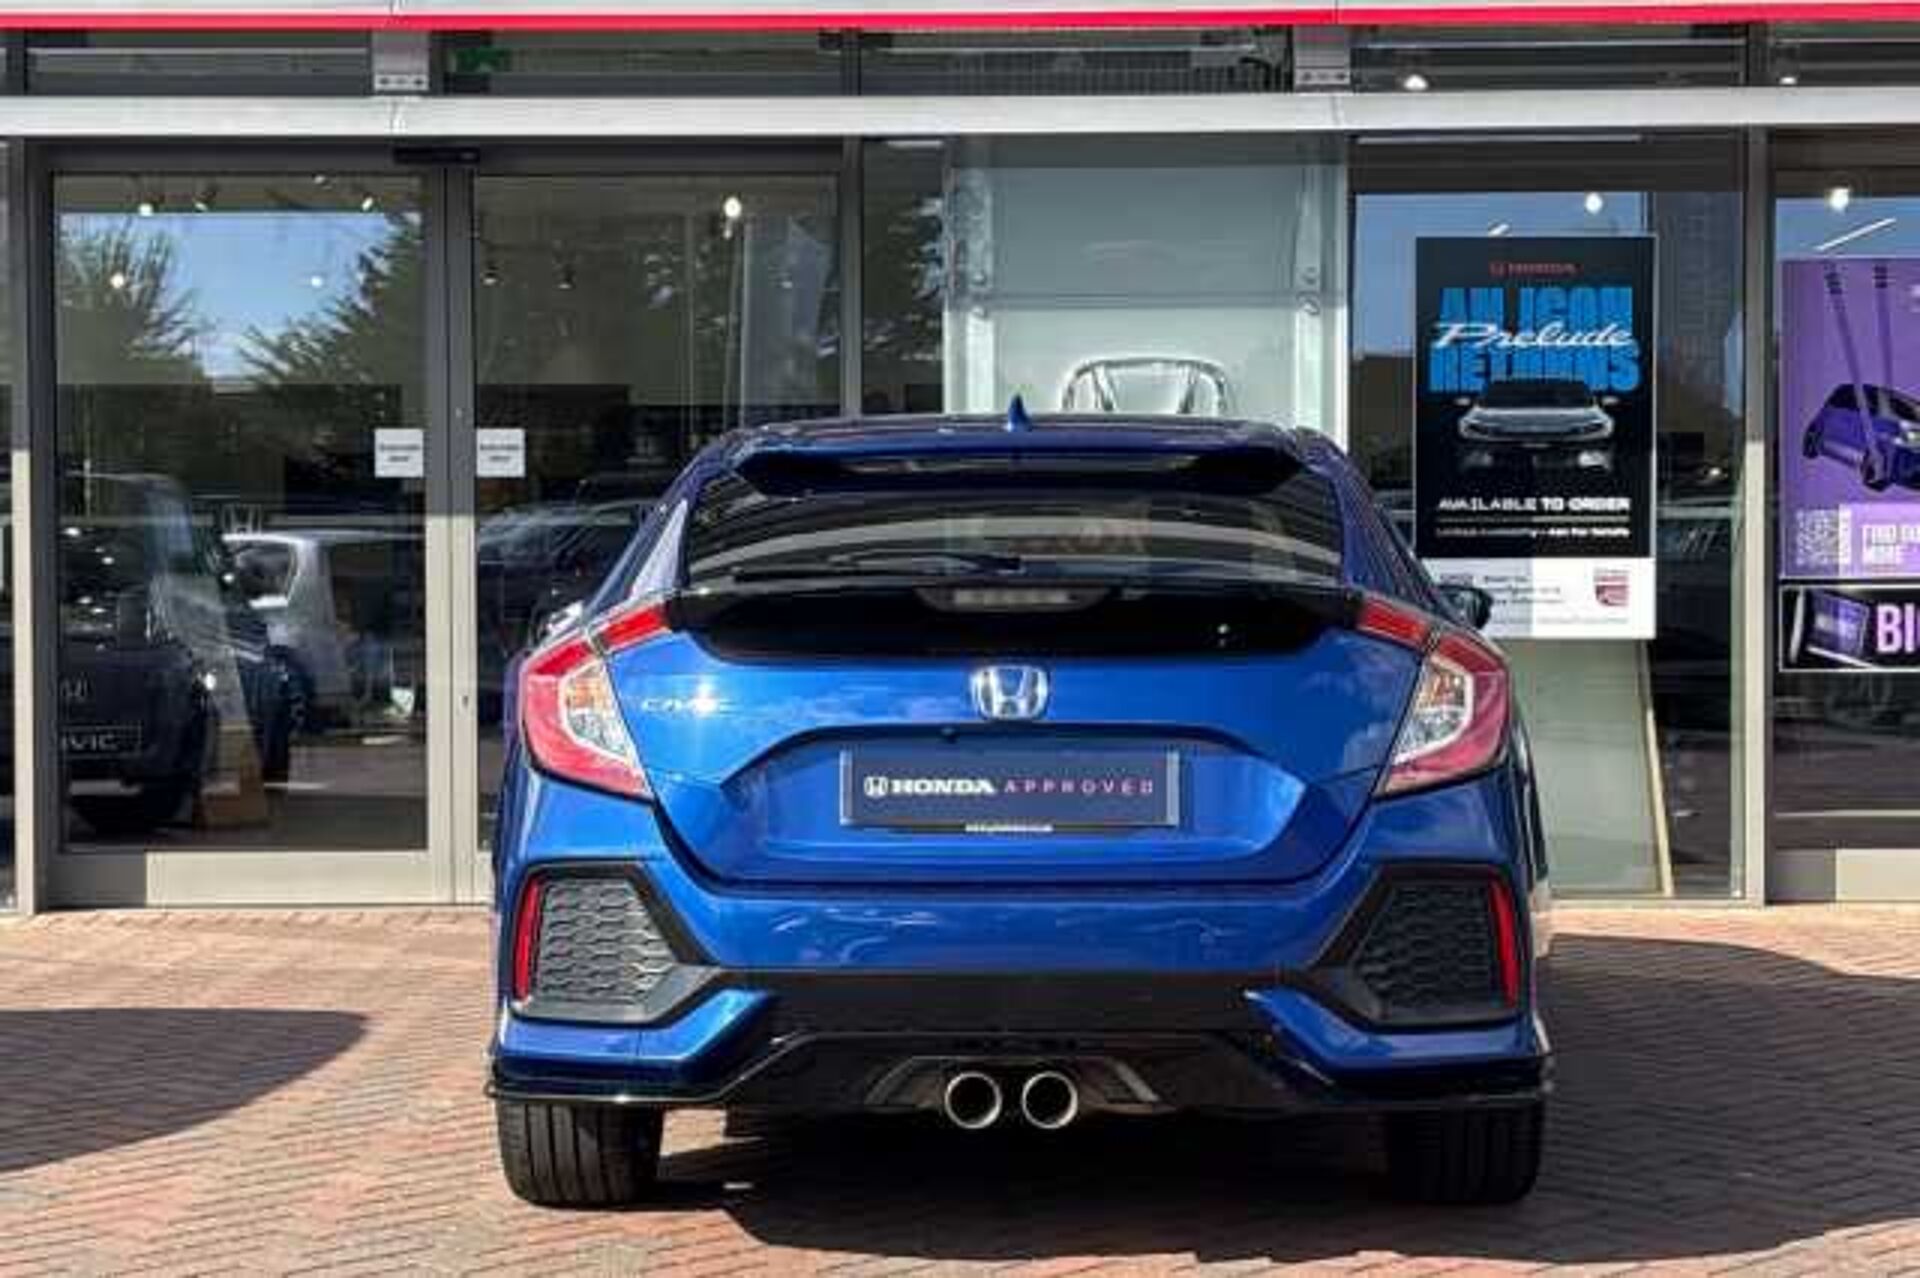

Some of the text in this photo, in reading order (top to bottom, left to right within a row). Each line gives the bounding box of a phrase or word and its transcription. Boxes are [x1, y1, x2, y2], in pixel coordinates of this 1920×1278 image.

[1434, 321, 1637, 348] Prelude
[1438, 497, 1631, 511] AVAILABLE TO ORDER
[1877, 603, 1920, 652] BI
[892, 778, 1154, 794] HONDA APPROVED
